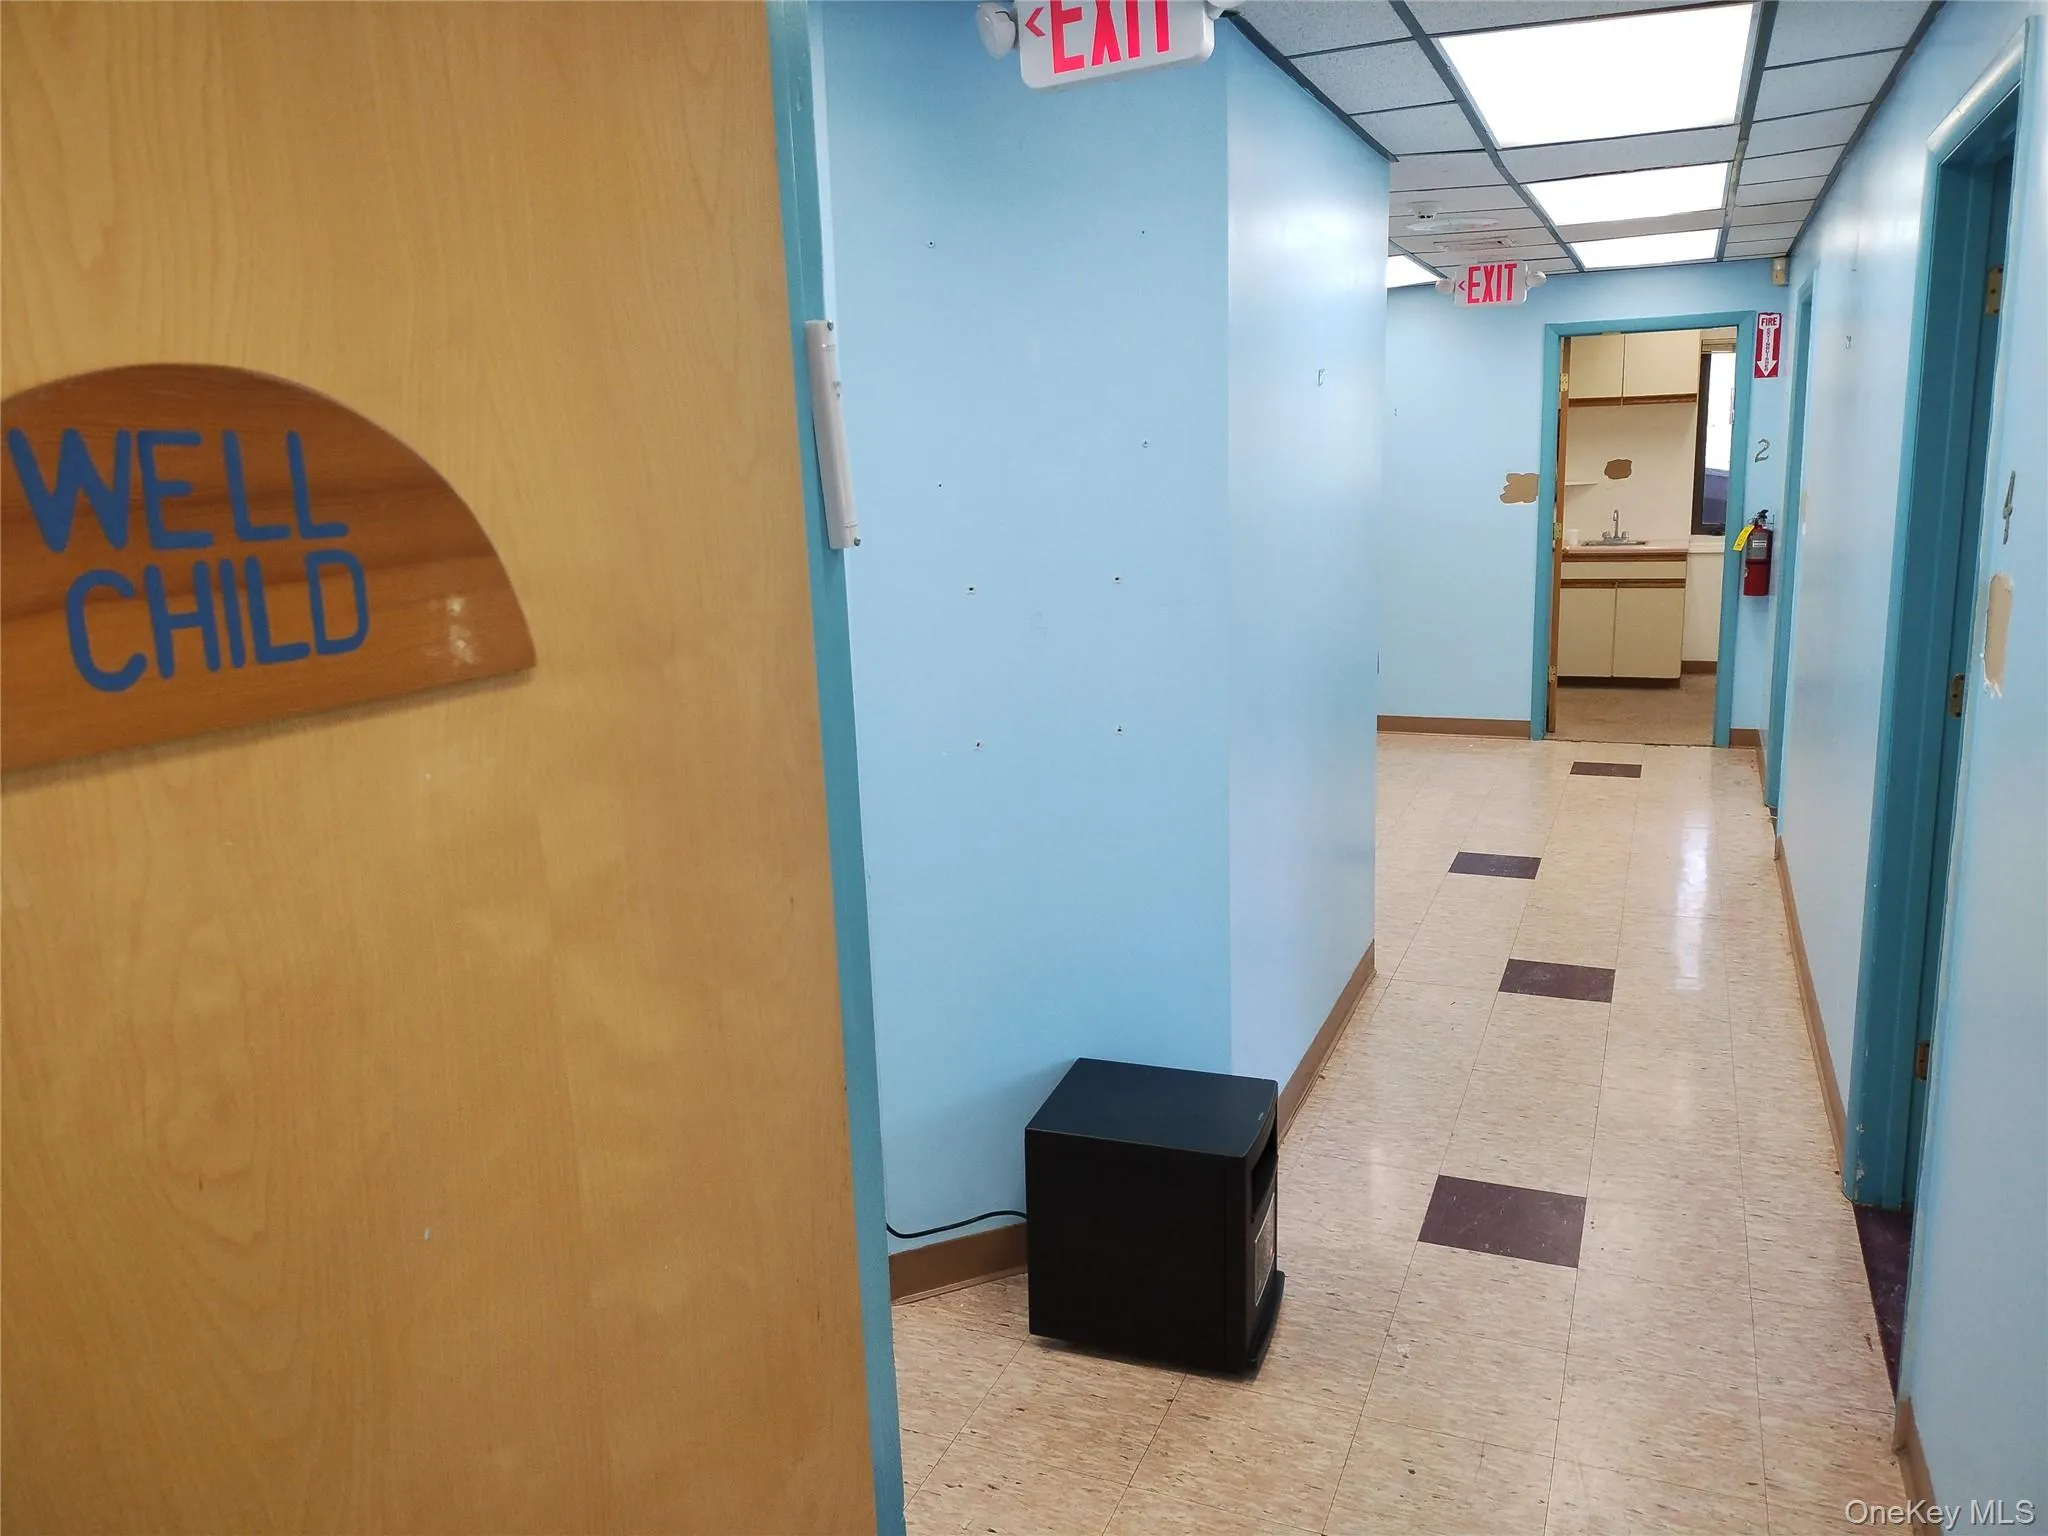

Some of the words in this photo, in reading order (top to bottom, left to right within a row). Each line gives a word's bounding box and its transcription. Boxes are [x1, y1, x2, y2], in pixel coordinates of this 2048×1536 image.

[1467, 263, 1517, 304] EXIT
[1761, 317, 1777, 326] FIRE
[1755, 438, 1770, 463] 2
[8, 427, 349, 553] WELL
[66, 549, 369, 692] CHILD
